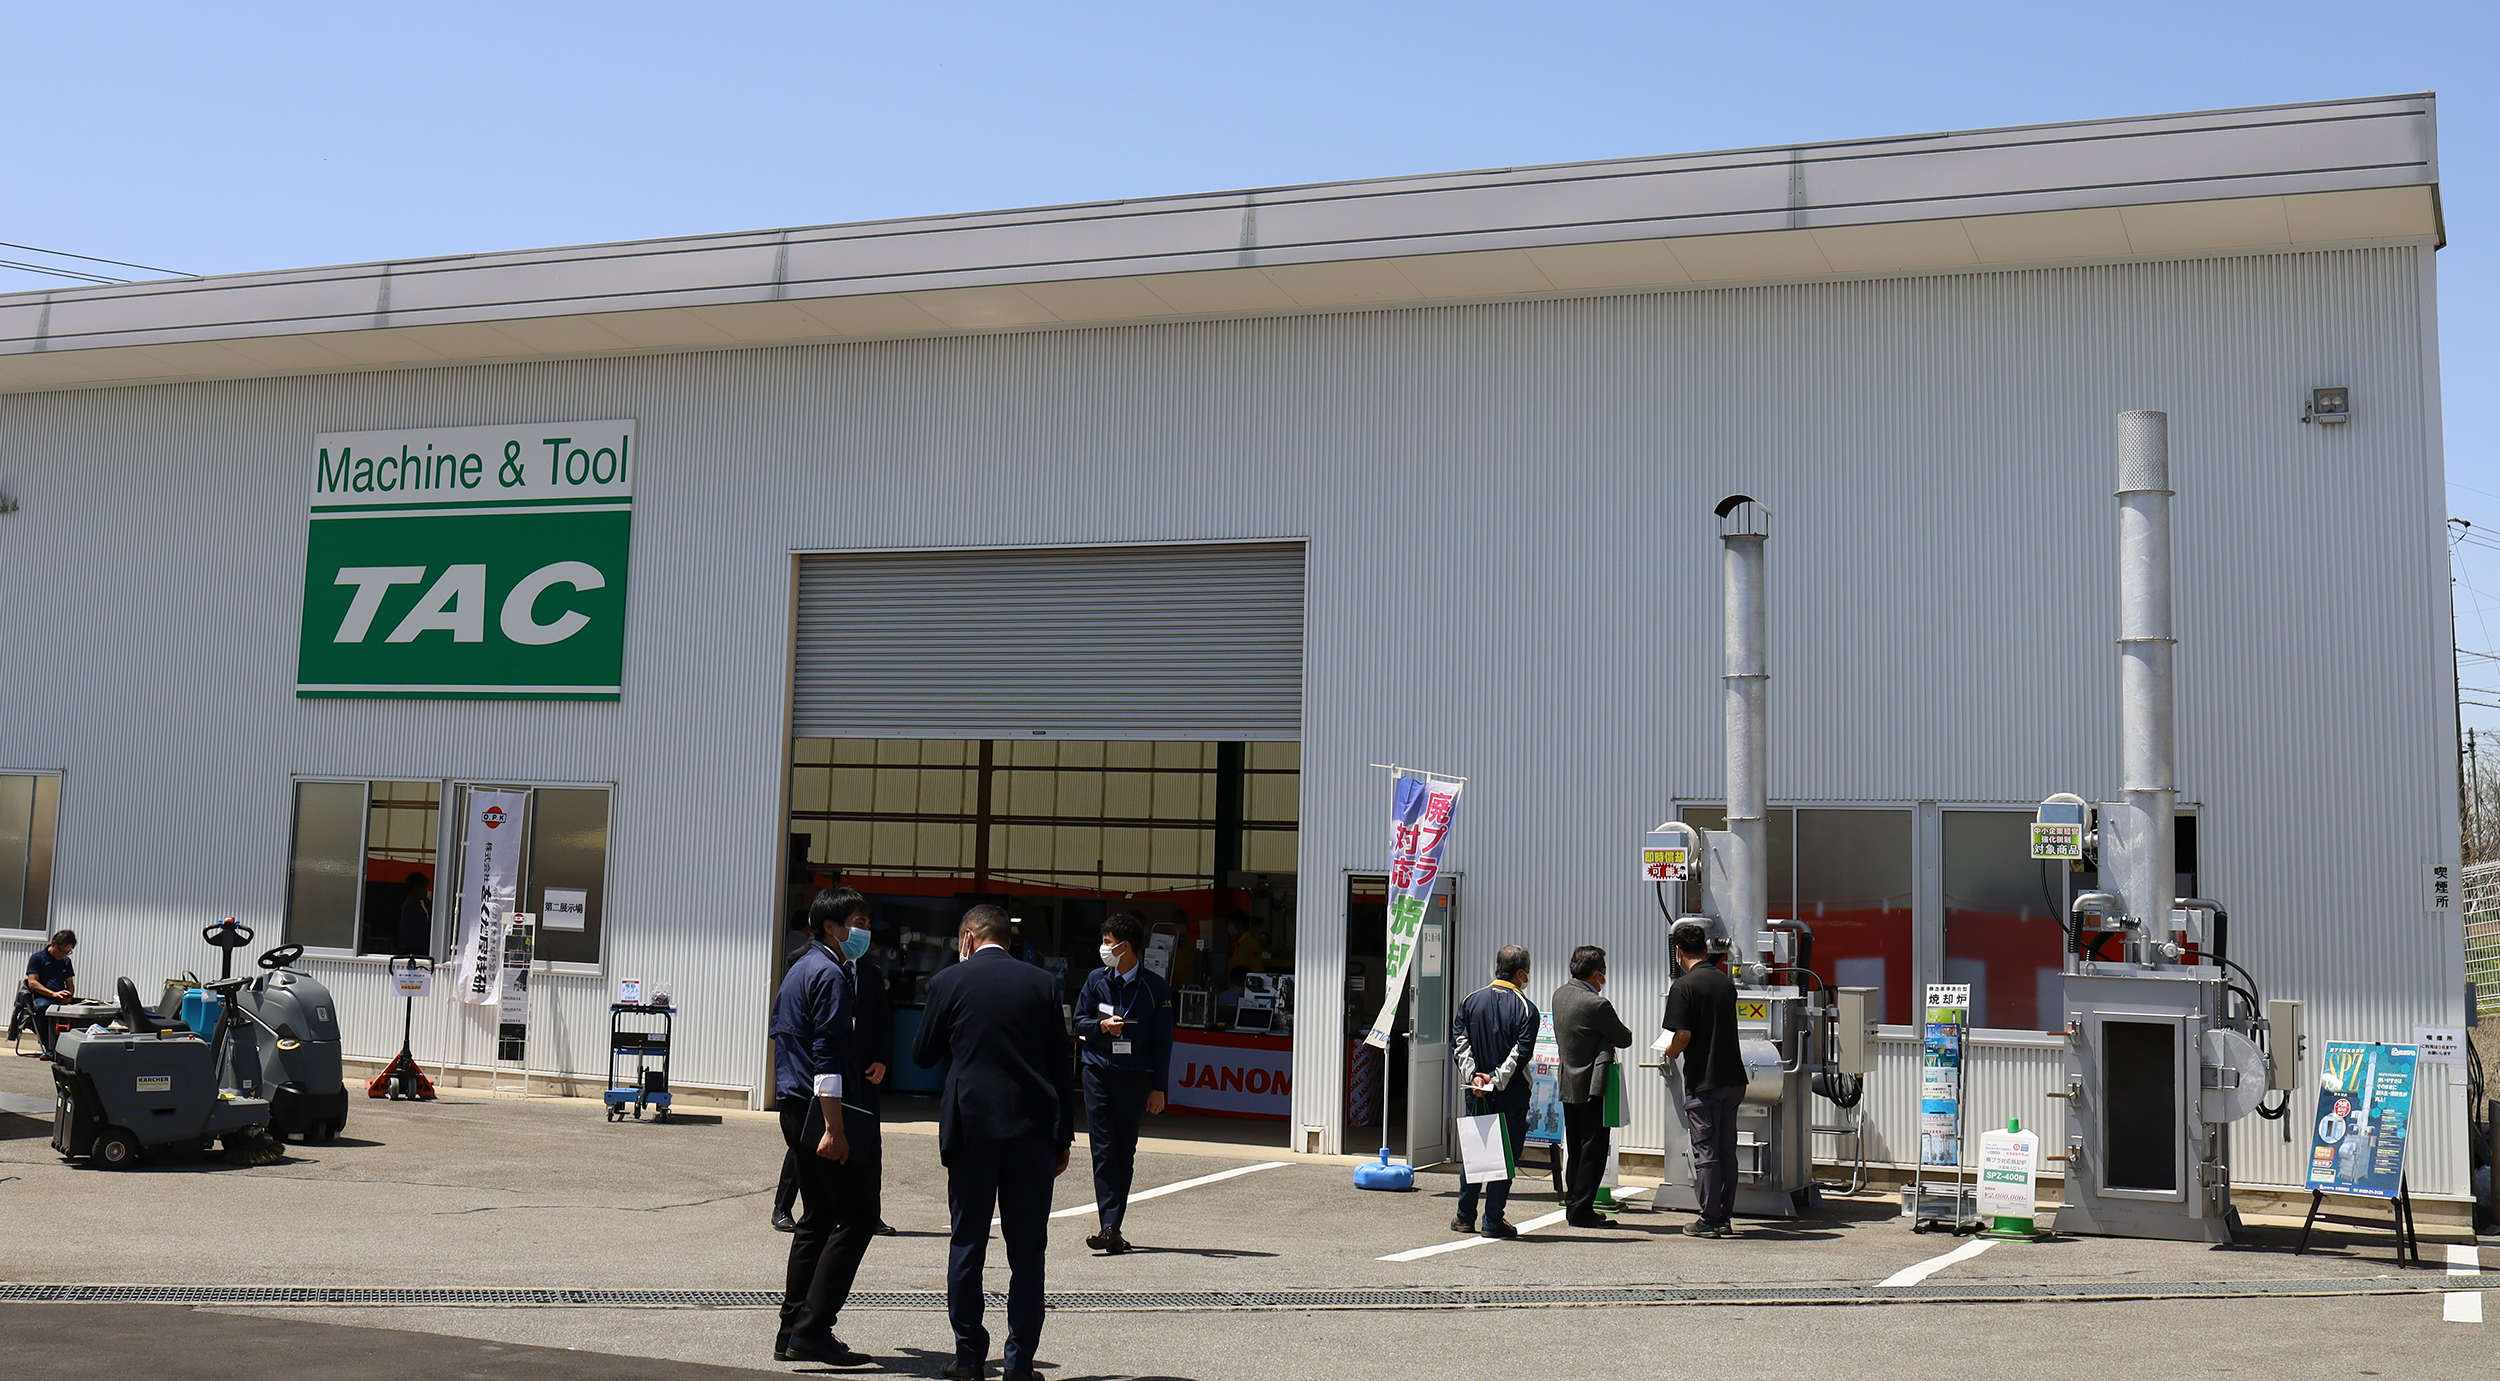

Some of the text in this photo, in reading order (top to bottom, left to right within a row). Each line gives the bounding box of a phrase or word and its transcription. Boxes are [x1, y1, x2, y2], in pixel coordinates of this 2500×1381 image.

[317, 435, 629, 493] Machine & Tool
[333, 560, 606, 646] TAC
[1424, 792, 1453, 885] 廃プラ
[2033, 844, 2079, 855] 対象商品
[1391, 822, 1420, 888] 対応
[1645, 850, 1685, 863] 即時償却
[1651, 866, 1677, 877] 可能
[2434, 866, 2449, 908] 喫煙所
[544, 902, 583, 914] 第二展示場
[1929, 993, 1967, 1005] 焼却炉
[2324, 1053, 2364, 1092] SPZ
[1986, 1171, 2025, 1182] SPZ-400型
